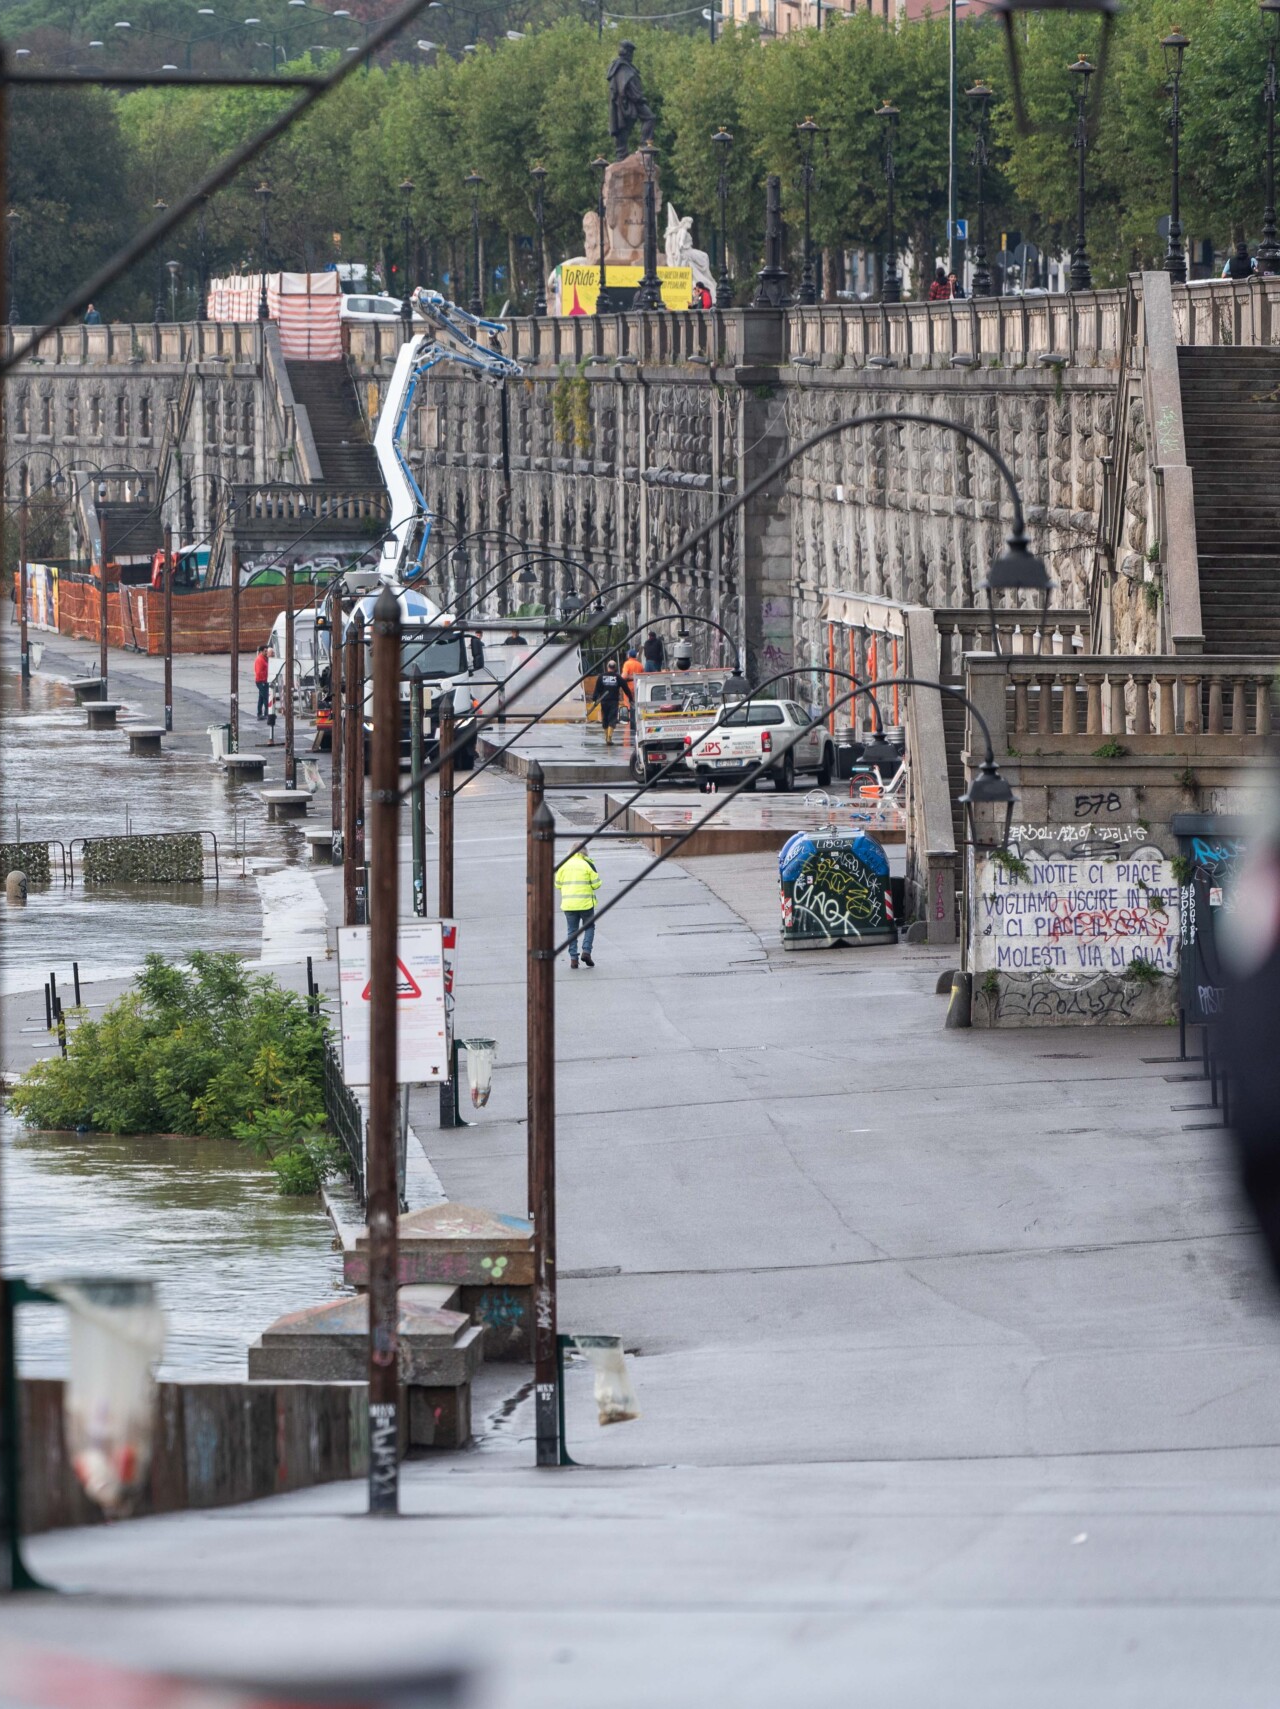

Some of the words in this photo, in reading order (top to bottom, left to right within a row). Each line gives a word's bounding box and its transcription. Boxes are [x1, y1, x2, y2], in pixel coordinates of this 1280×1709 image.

[1074, 793, 1122, 817] 578
[1033, 864, 1078, 885] NOTTE
[1088, 865, 1103, 884] CI
[1117, 864, 1162, 884] PIACE
[983, 890, 1058, 916] VOGLIAMO
[1069, 889, 1118, 911] USCIRE
[1127, 889, 1140, 909] IN
[1006, 918, 1023, 936] CI
[1035, 916, 1083, 937] PIACE
[1093, 917, 1107, 936] IL
[997, 946, 1067, 968] MOLESTI
[1077, 943, 1103, 967] VIA
[1111, 946, 1125, 966] DI
